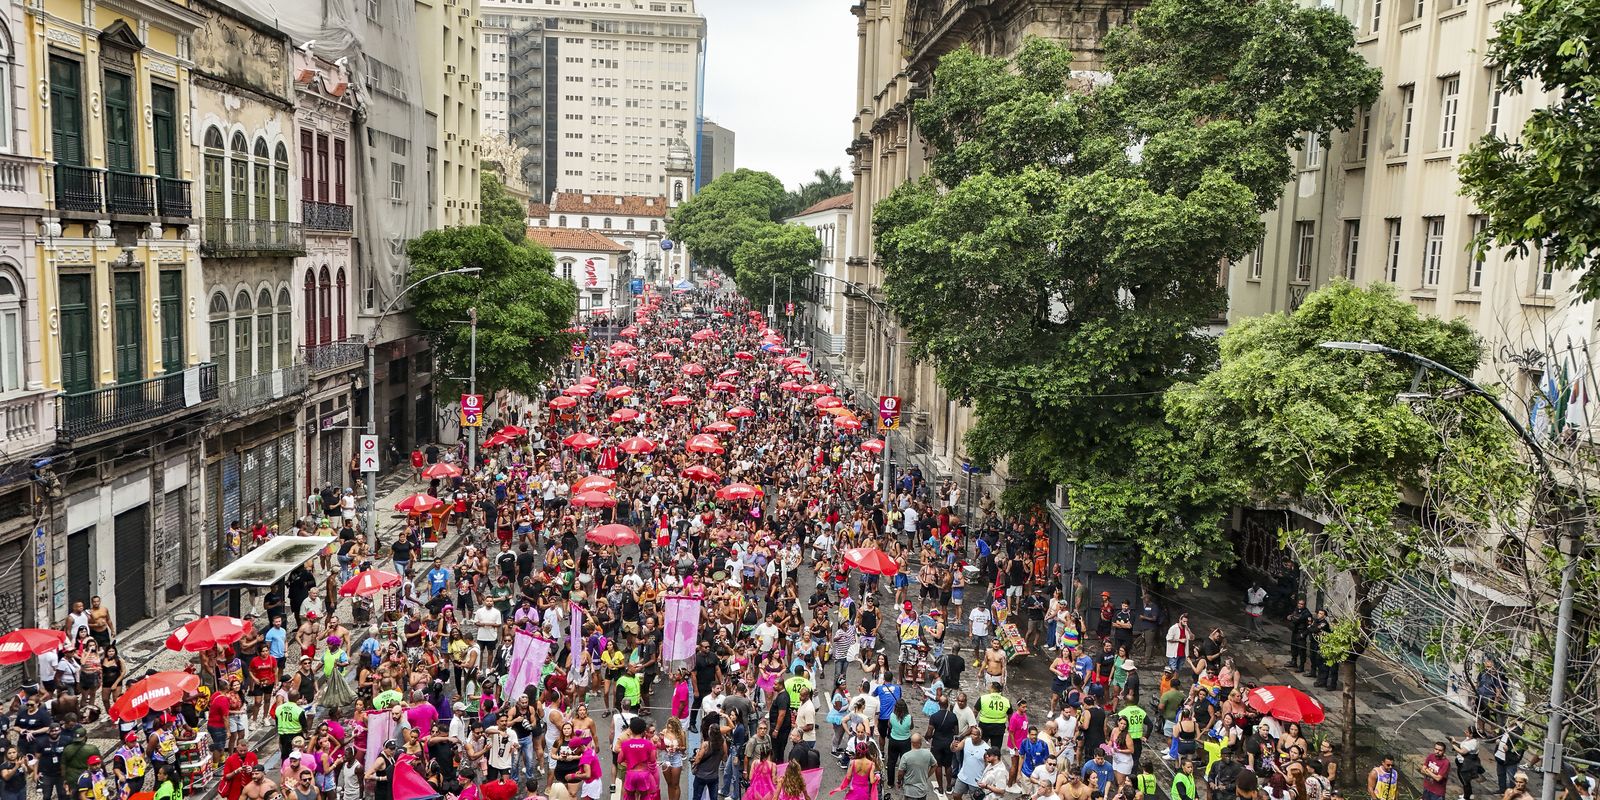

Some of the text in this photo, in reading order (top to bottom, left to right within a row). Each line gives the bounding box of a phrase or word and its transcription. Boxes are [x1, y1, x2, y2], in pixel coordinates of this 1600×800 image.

[132, 687, 171, 708] BRAHMA
[988, 701, 1004, 711] 419
[1130, 715, 1142, 725] 636
